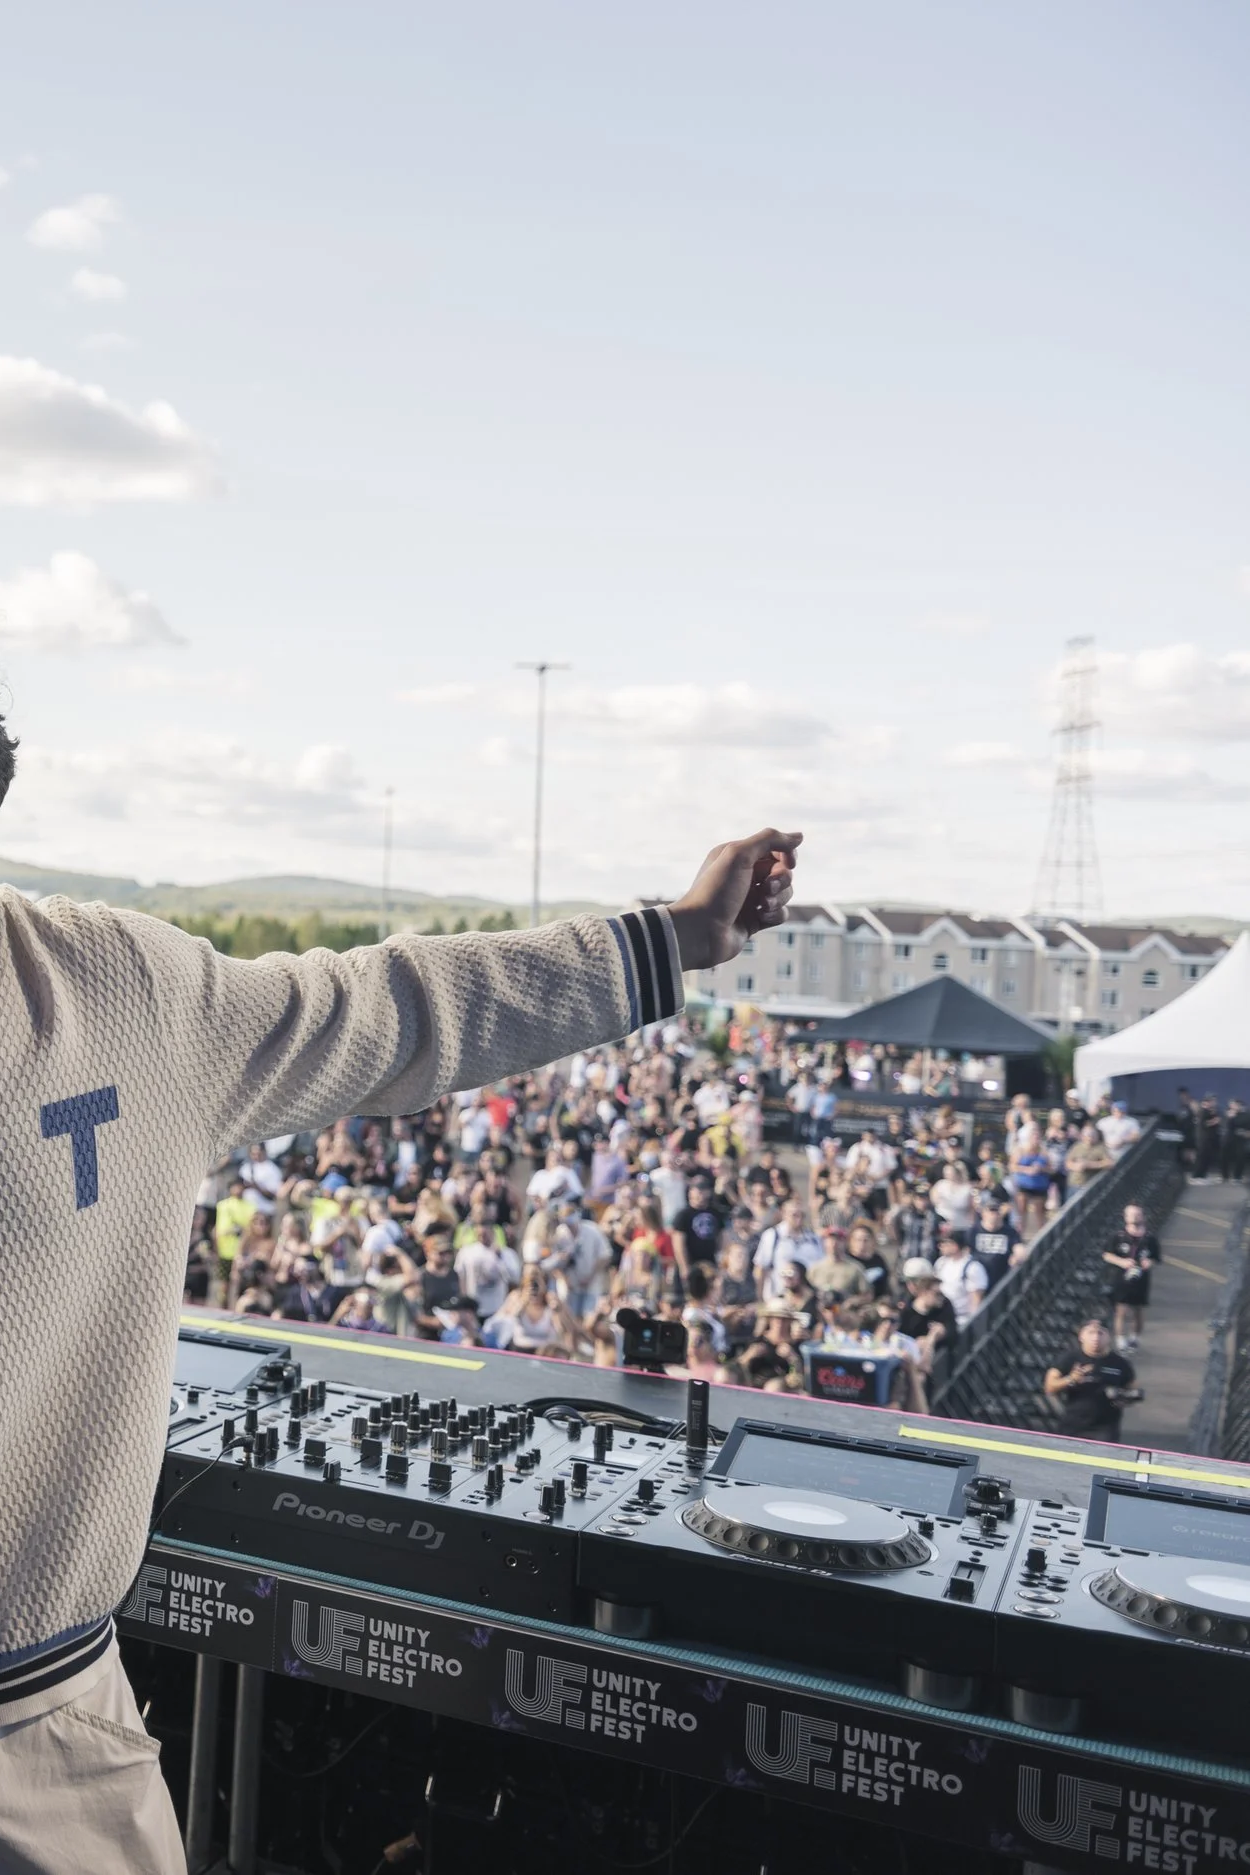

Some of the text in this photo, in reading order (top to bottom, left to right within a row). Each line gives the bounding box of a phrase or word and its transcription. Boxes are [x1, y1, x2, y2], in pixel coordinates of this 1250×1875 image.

[40, 1085, 120, 1211] T
[272, 1492, 401, 1534] Pioneer
[170, 1570, 226, 1598] UNITY
[168, 1611, 213, 1637] FEST
[169, 1590, 255, 1625] ELECTRO
[369, 1617, 431, 1648] UNITY
[366, 1660, 417, 1688] FEST
[367, 1639, 463, 1677] ELECTRO
[592, 1668, 661, 1700] UNITY
[591, 1690, 698, 1732] ELECTRO
[590, 1713, 646, 1744] FEST
[844, 1725, 922, 1761] UNITY
[842, 1749, 963, 1795] ELECTRO
[841, 1773, 904, 1806] FEST
[1129, 1790, 1218, 1828] UNITY
[1126, 1841, 1198, 1875] FEST
